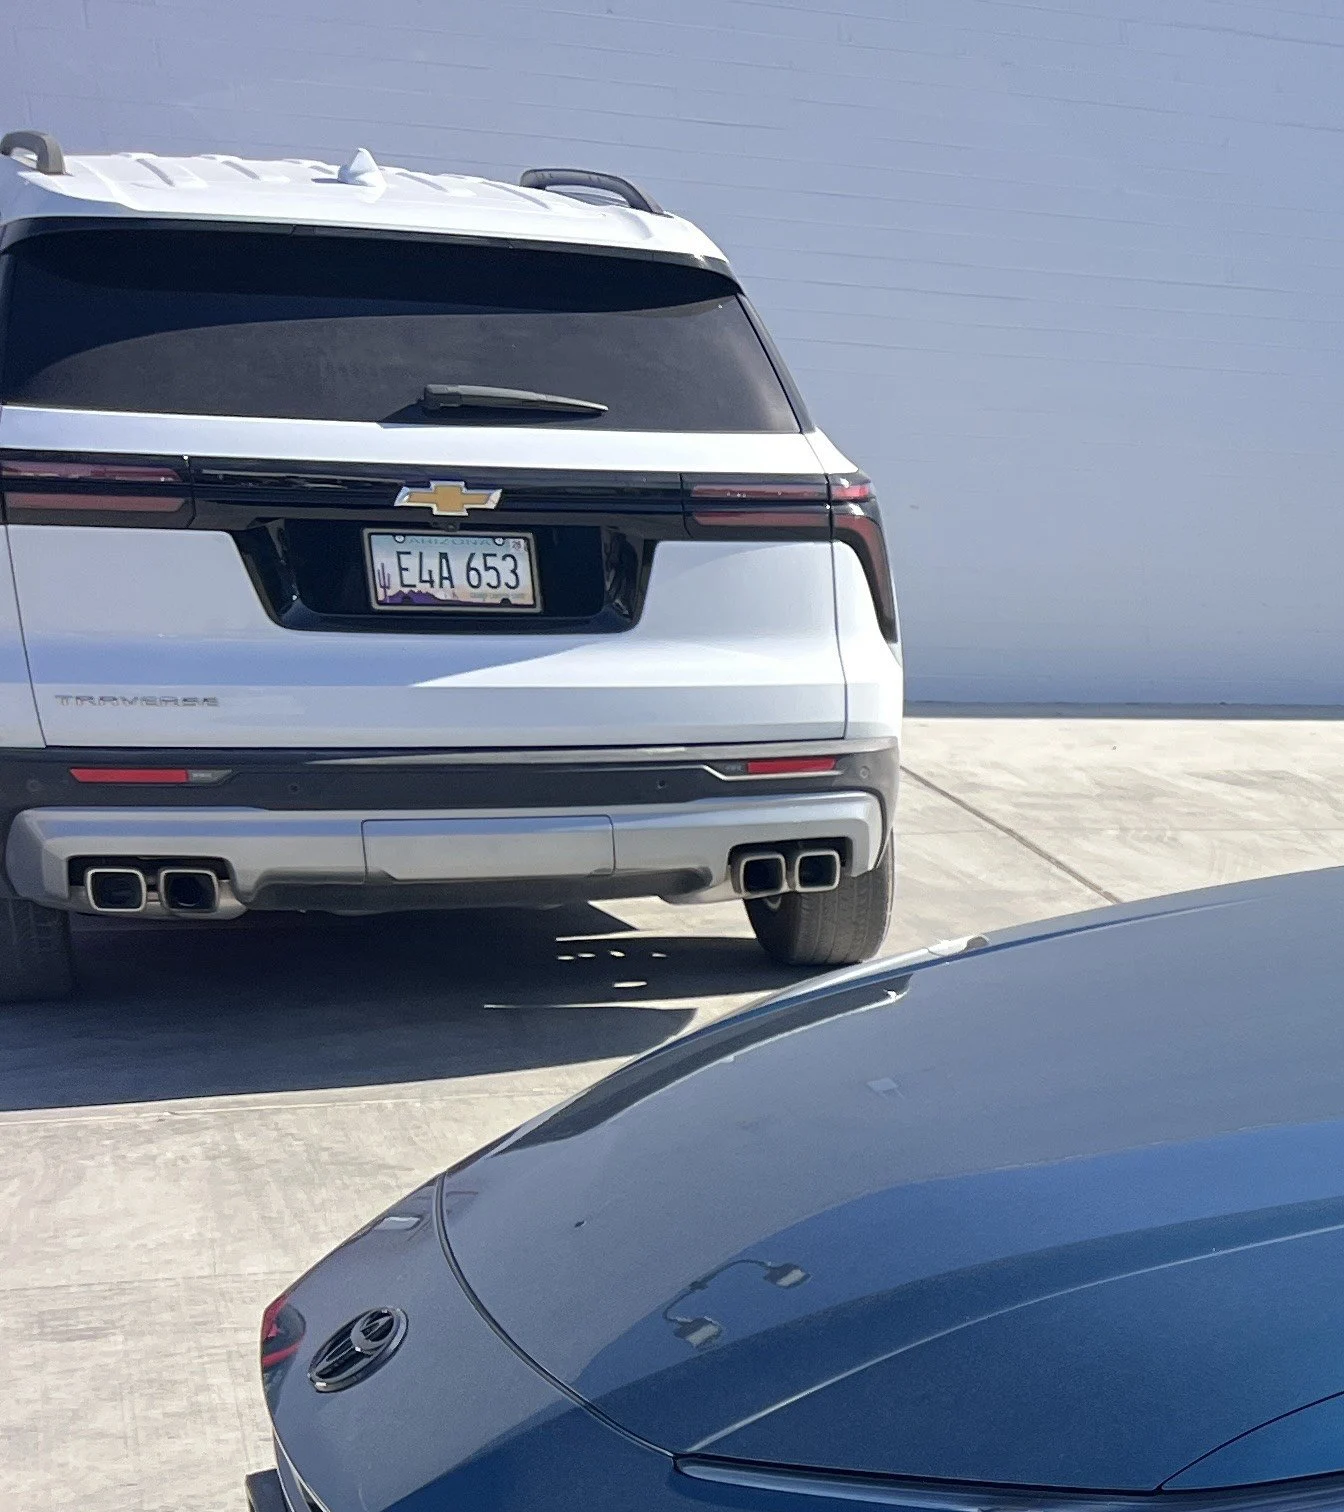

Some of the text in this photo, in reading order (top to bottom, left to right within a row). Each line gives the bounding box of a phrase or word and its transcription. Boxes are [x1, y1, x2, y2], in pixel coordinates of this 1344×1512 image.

[396, 550, 520, 590] E4A 653
[54, 694, 220, 707] TRAVERSE
